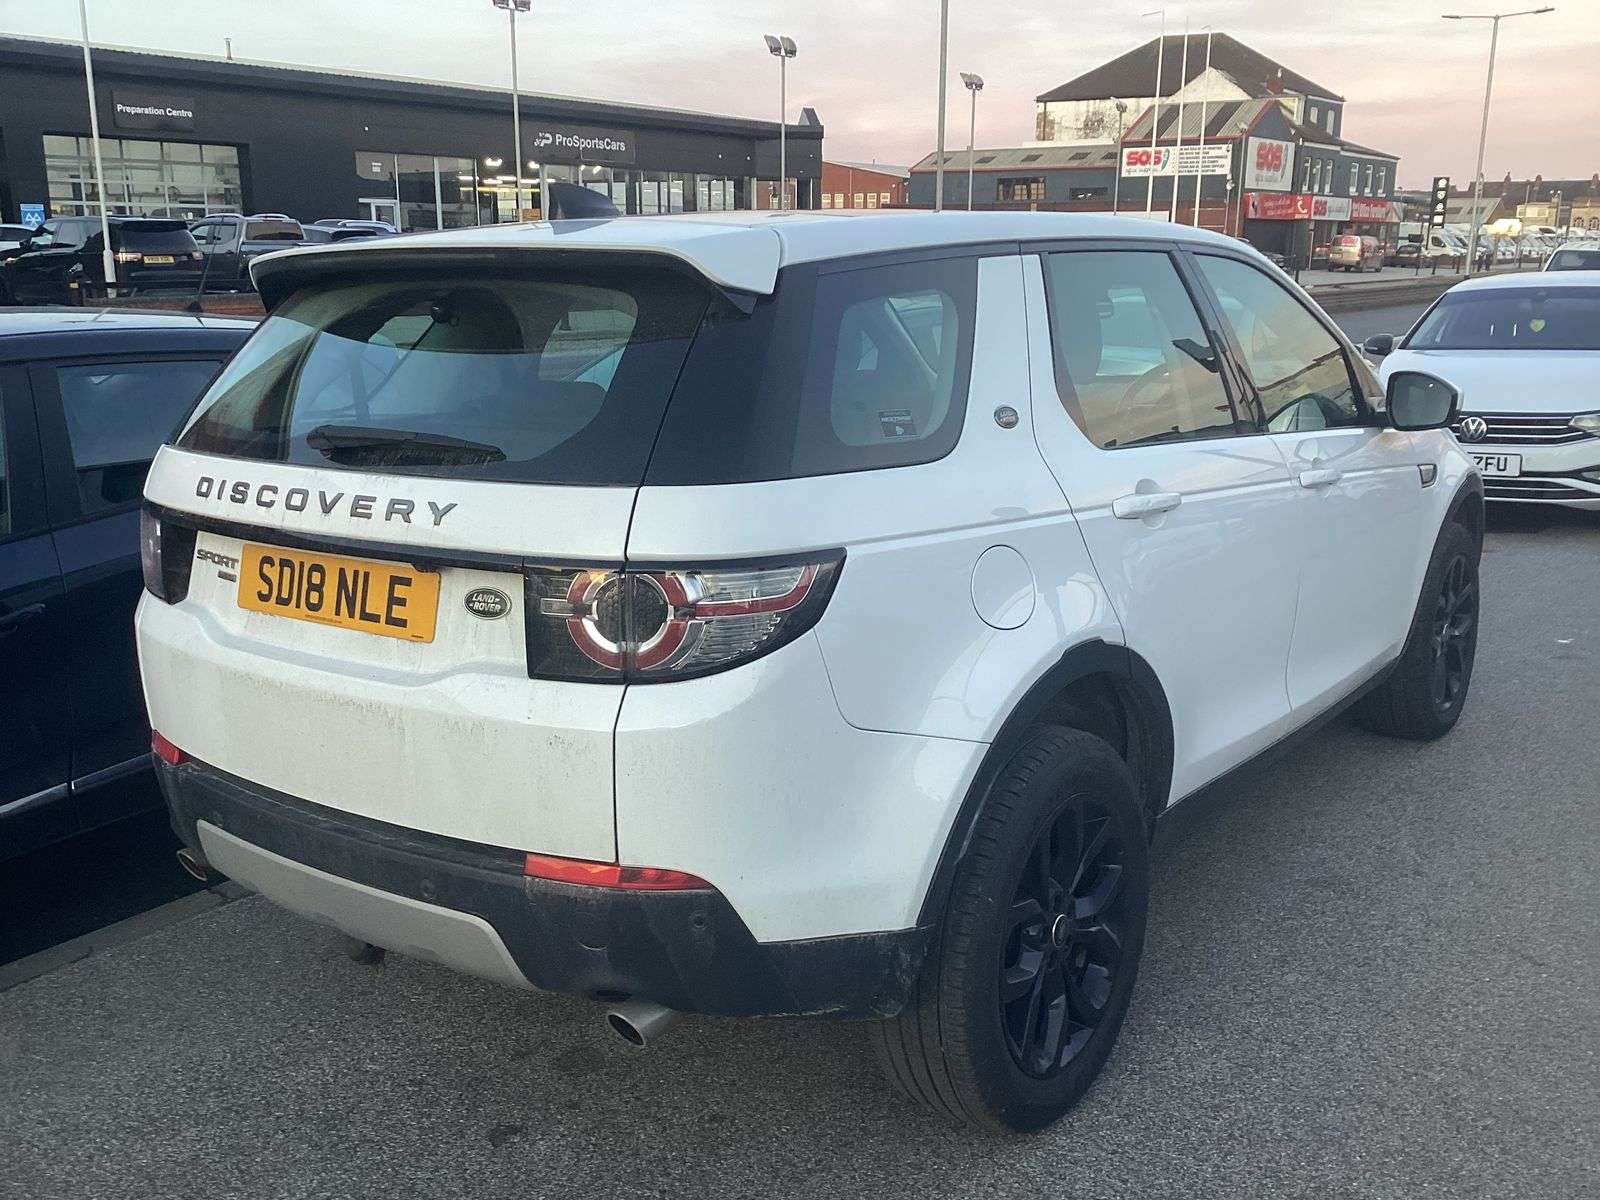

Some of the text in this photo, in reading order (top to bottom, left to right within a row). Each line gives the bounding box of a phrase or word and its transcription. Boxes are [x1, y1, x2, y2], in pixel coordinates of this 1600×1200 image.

[116, 103, 193, 118] Preparation Centre
[555, 133, 626, 151] ProSportsCars
[1256, 142, 1283, 172] SOS
[196, 476, 458, 525] DISCOVERY
[196, 549, 239, 569] SPORT
[257, 555, 413, 629] SD18 NLE
